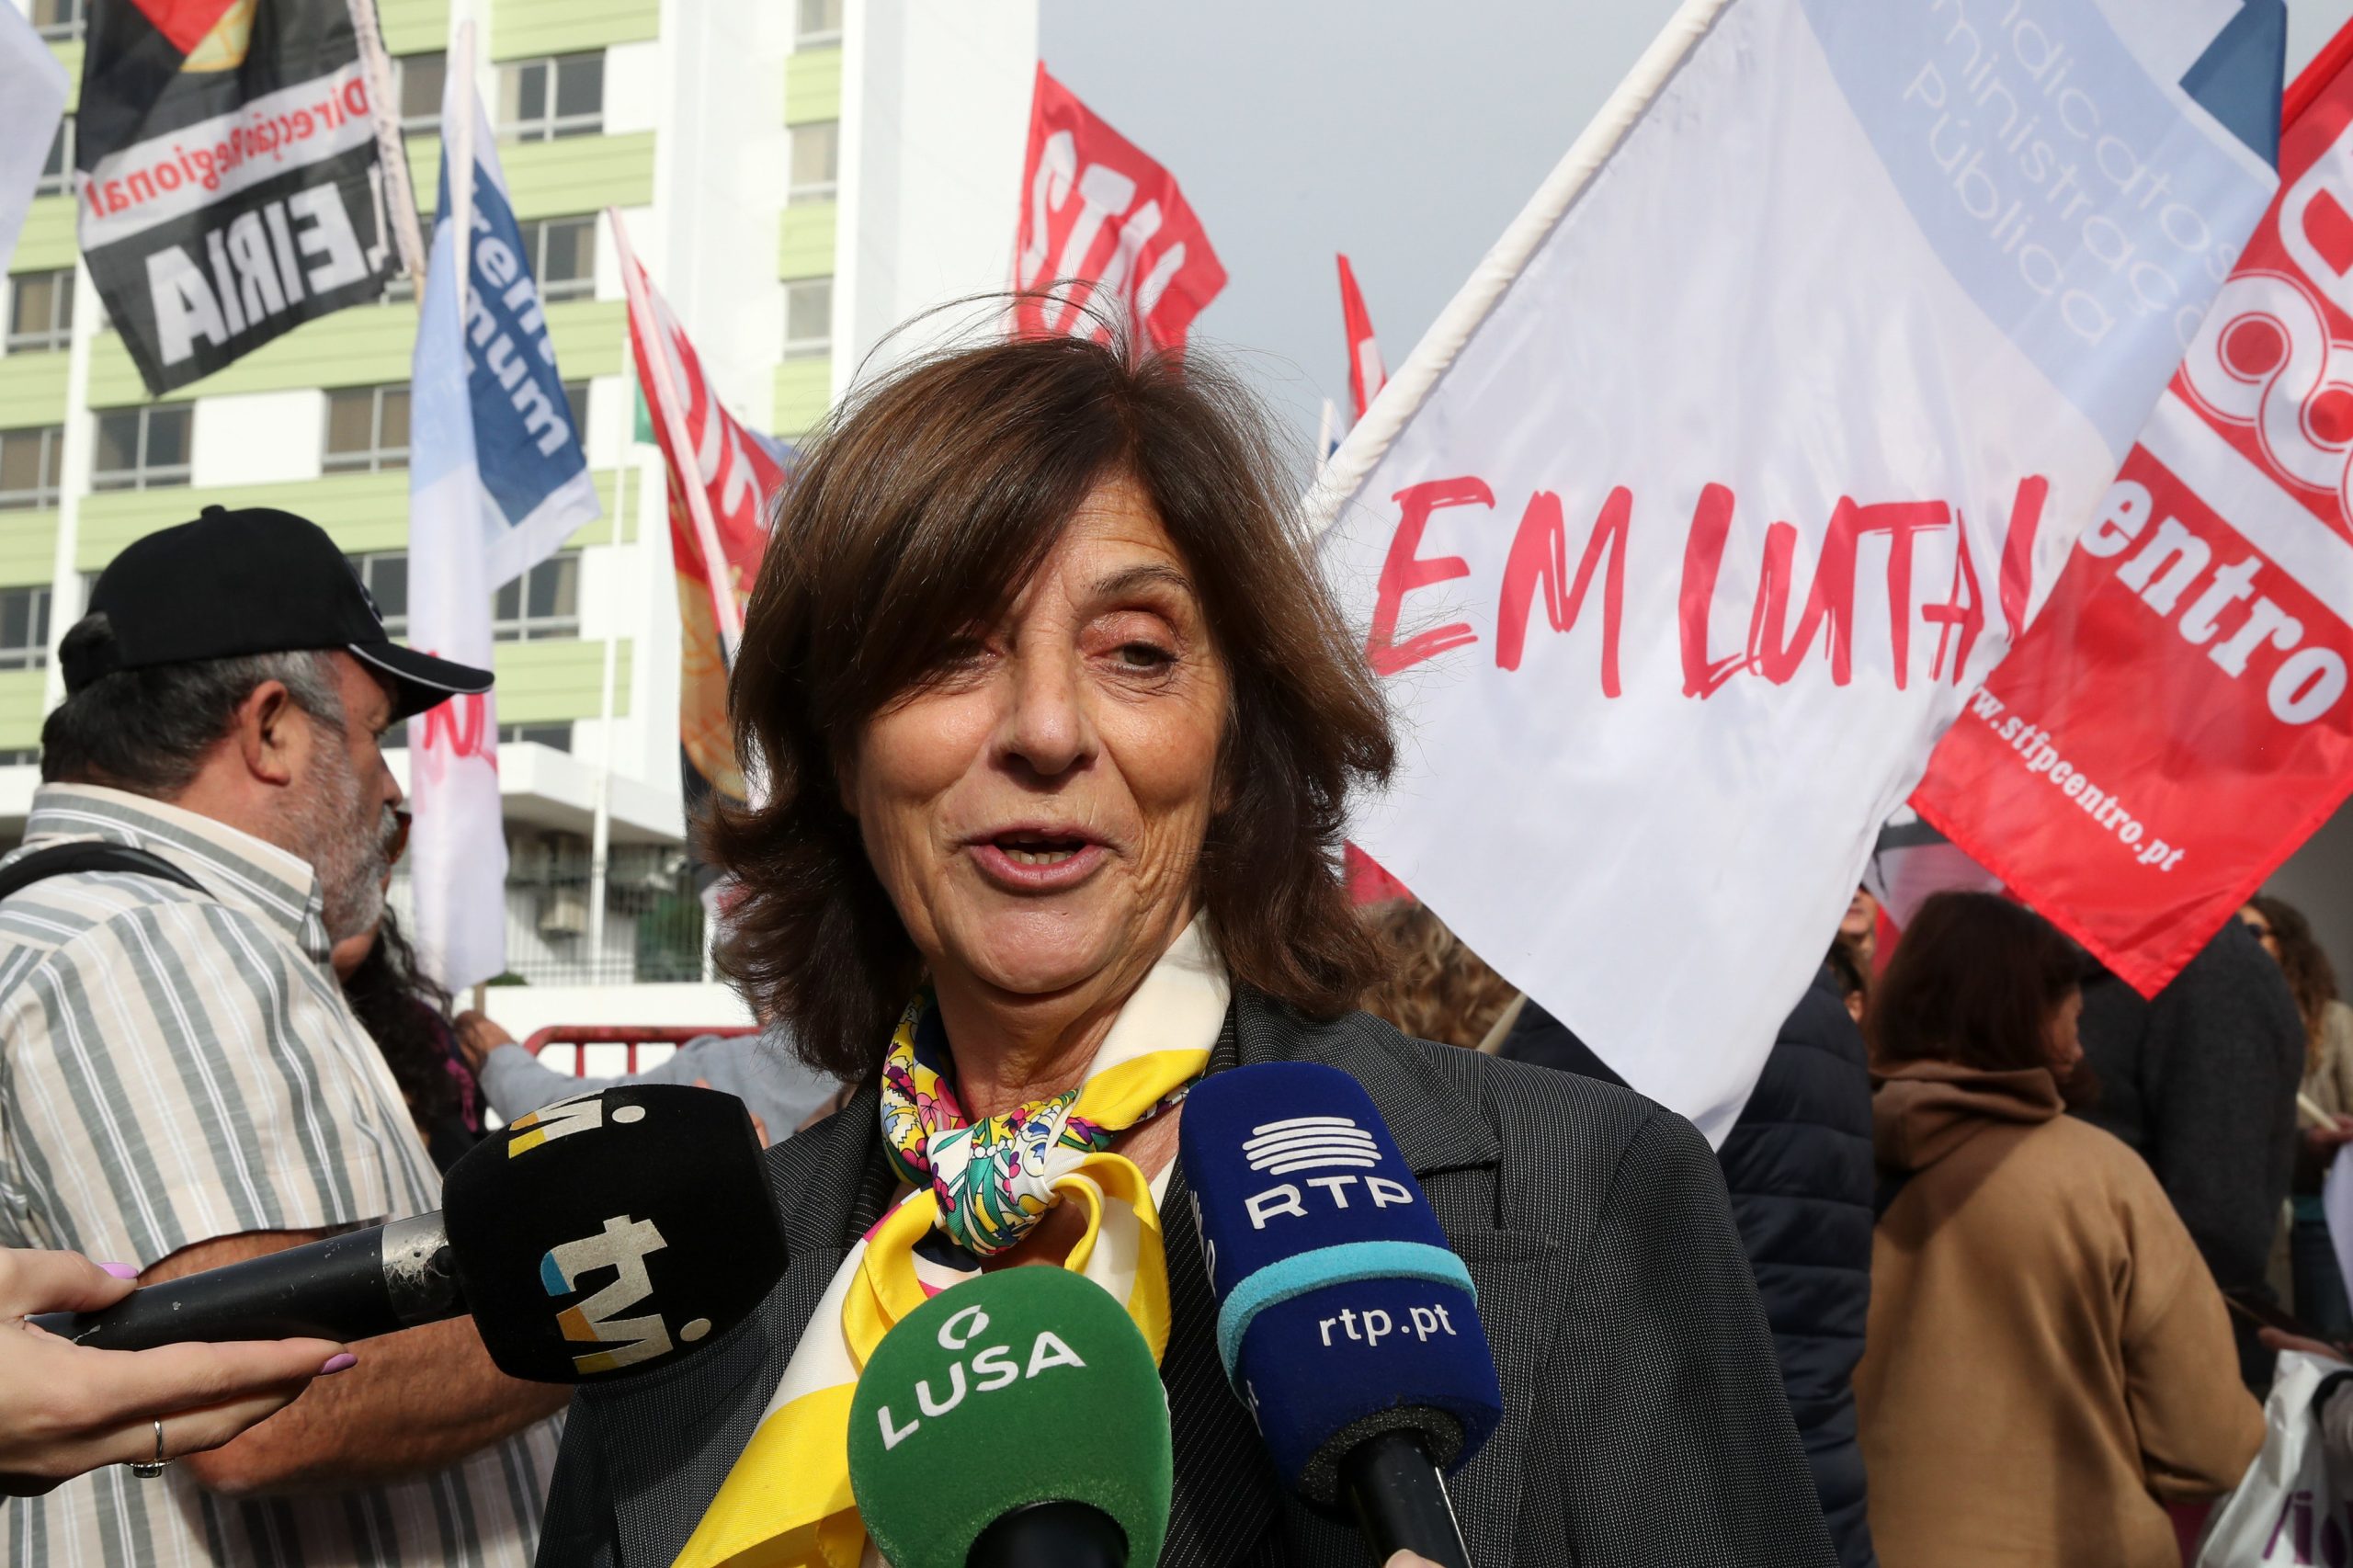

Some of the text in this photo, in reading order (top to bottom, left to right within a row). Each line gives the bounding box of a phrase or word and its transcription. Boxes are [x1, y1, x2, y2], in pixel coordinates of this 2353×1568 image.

[1899, 59, 2115, 347] Pública
[1363, 473, 2050, 700] EM LUTA!
[1244, 1176, 1415, 1231] RTP
[540, 1214, 712, 1376] tvi
[1318, 1302, 1457, 1347] rtp.pt
[877, 1330, 1086, 1452] LUSA
